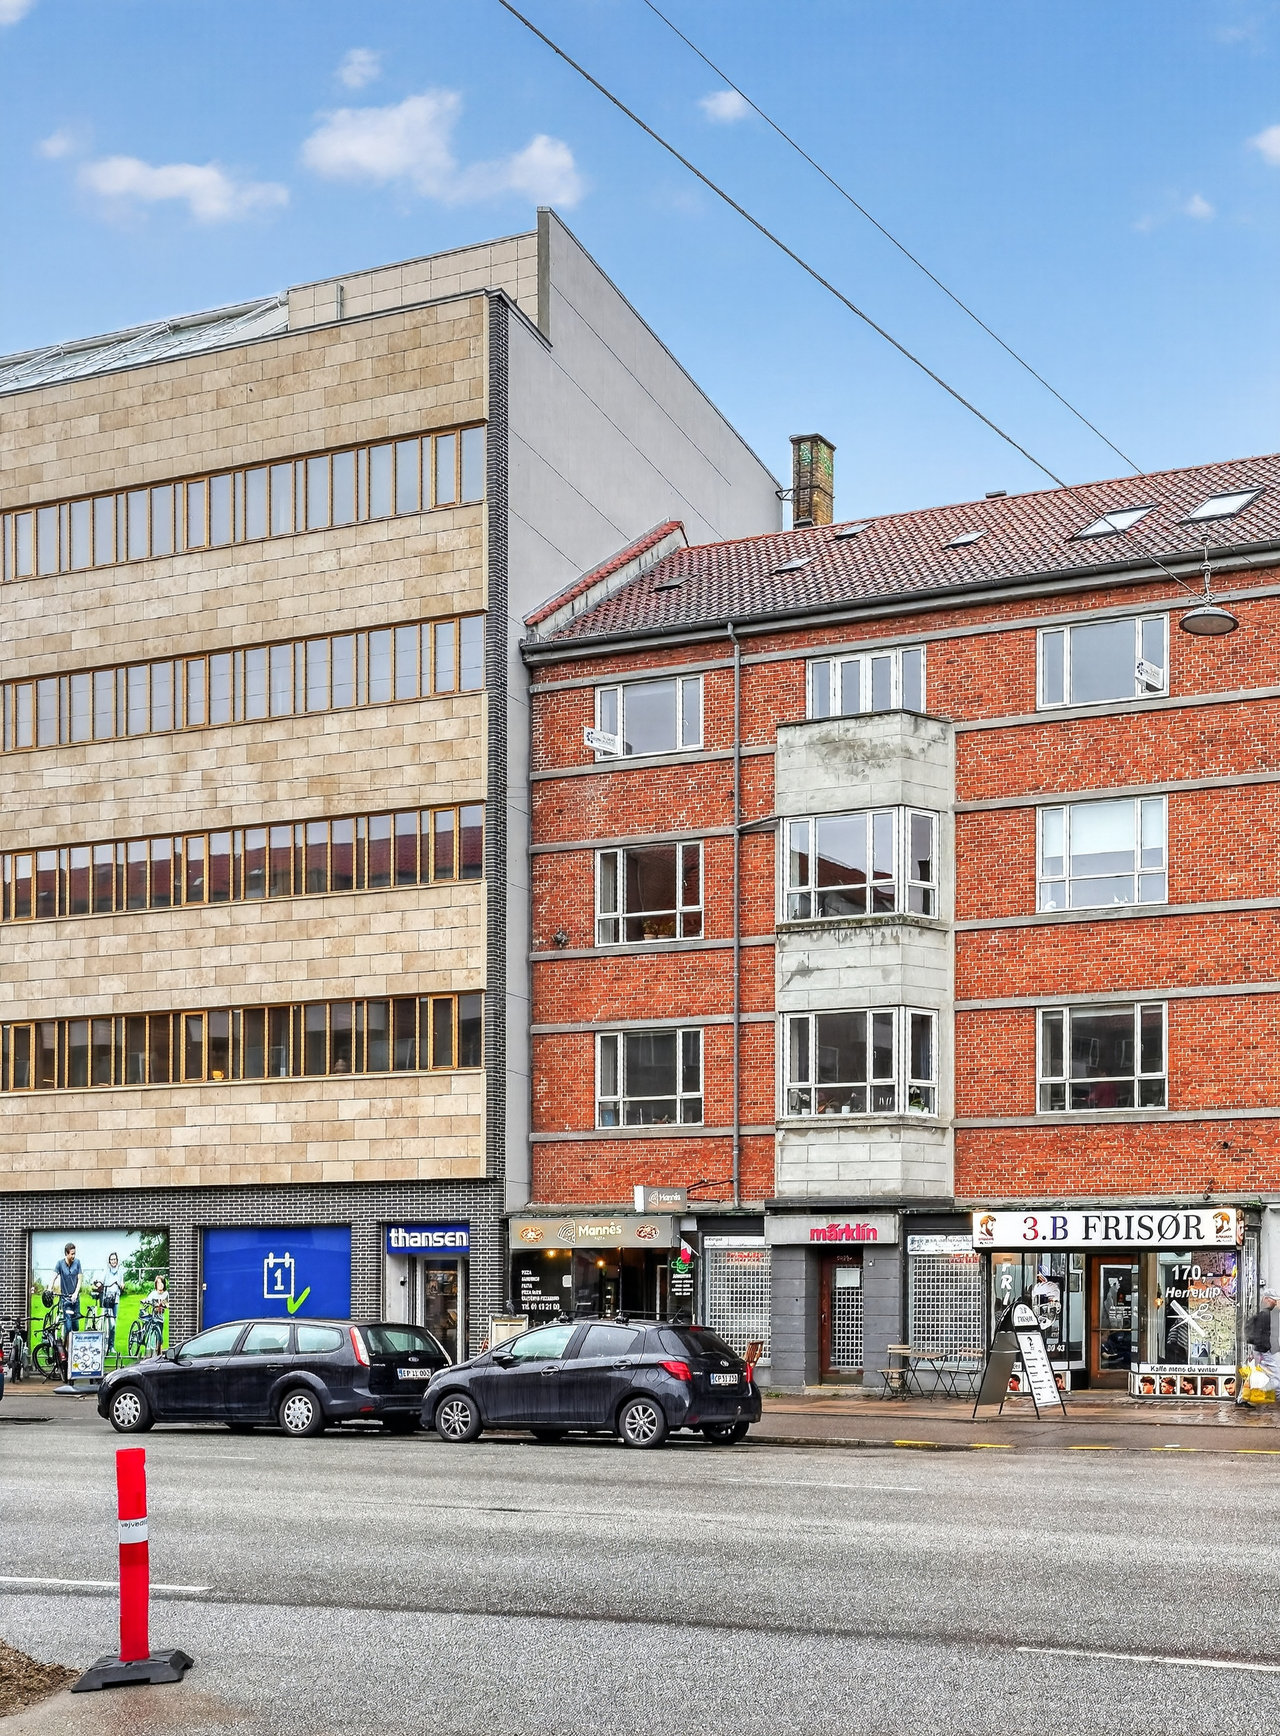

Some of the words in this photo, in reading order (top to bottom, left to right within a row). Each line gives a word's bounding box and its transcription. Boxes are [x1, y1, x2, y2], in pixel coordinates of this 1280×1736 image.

[1022, 1216, 1069, 1241] 3.B
[1082, 1213, 1205, 1242] FRISØR
[389, 1228, 469, 1247] thansen
[1165, 1286, 1221, 1299] Herreklip
